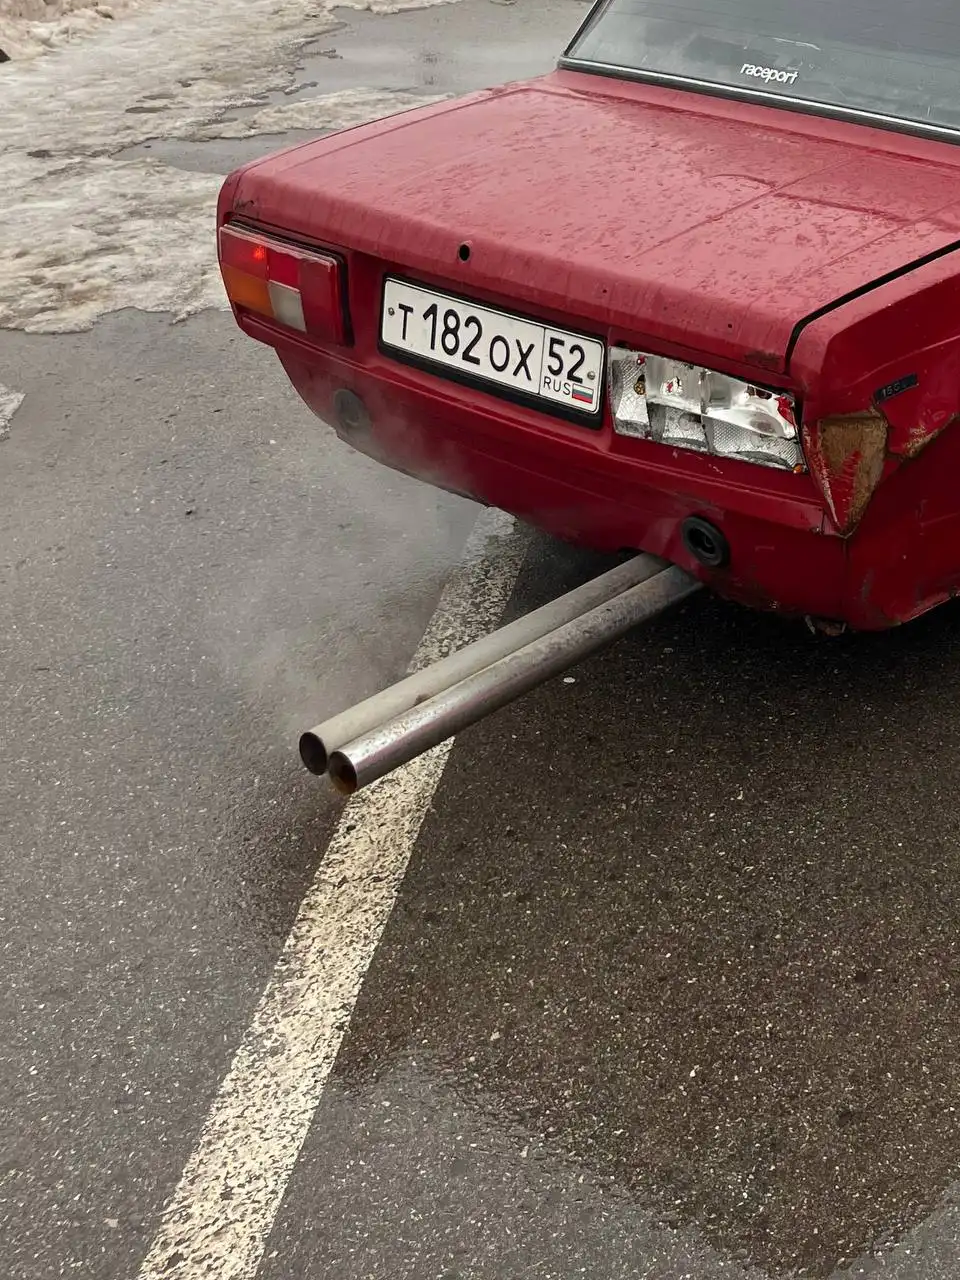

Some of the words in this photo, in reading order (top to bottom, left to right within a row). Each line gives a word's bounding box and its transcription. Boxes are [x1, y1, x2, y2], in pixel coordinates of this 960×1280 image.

[740, 63, 799, 84] raceport
[398, 303, 535, 381] Т182ОХ
[547, 337, 586, 383] 52
[543, 376, 571, 396] RUS
